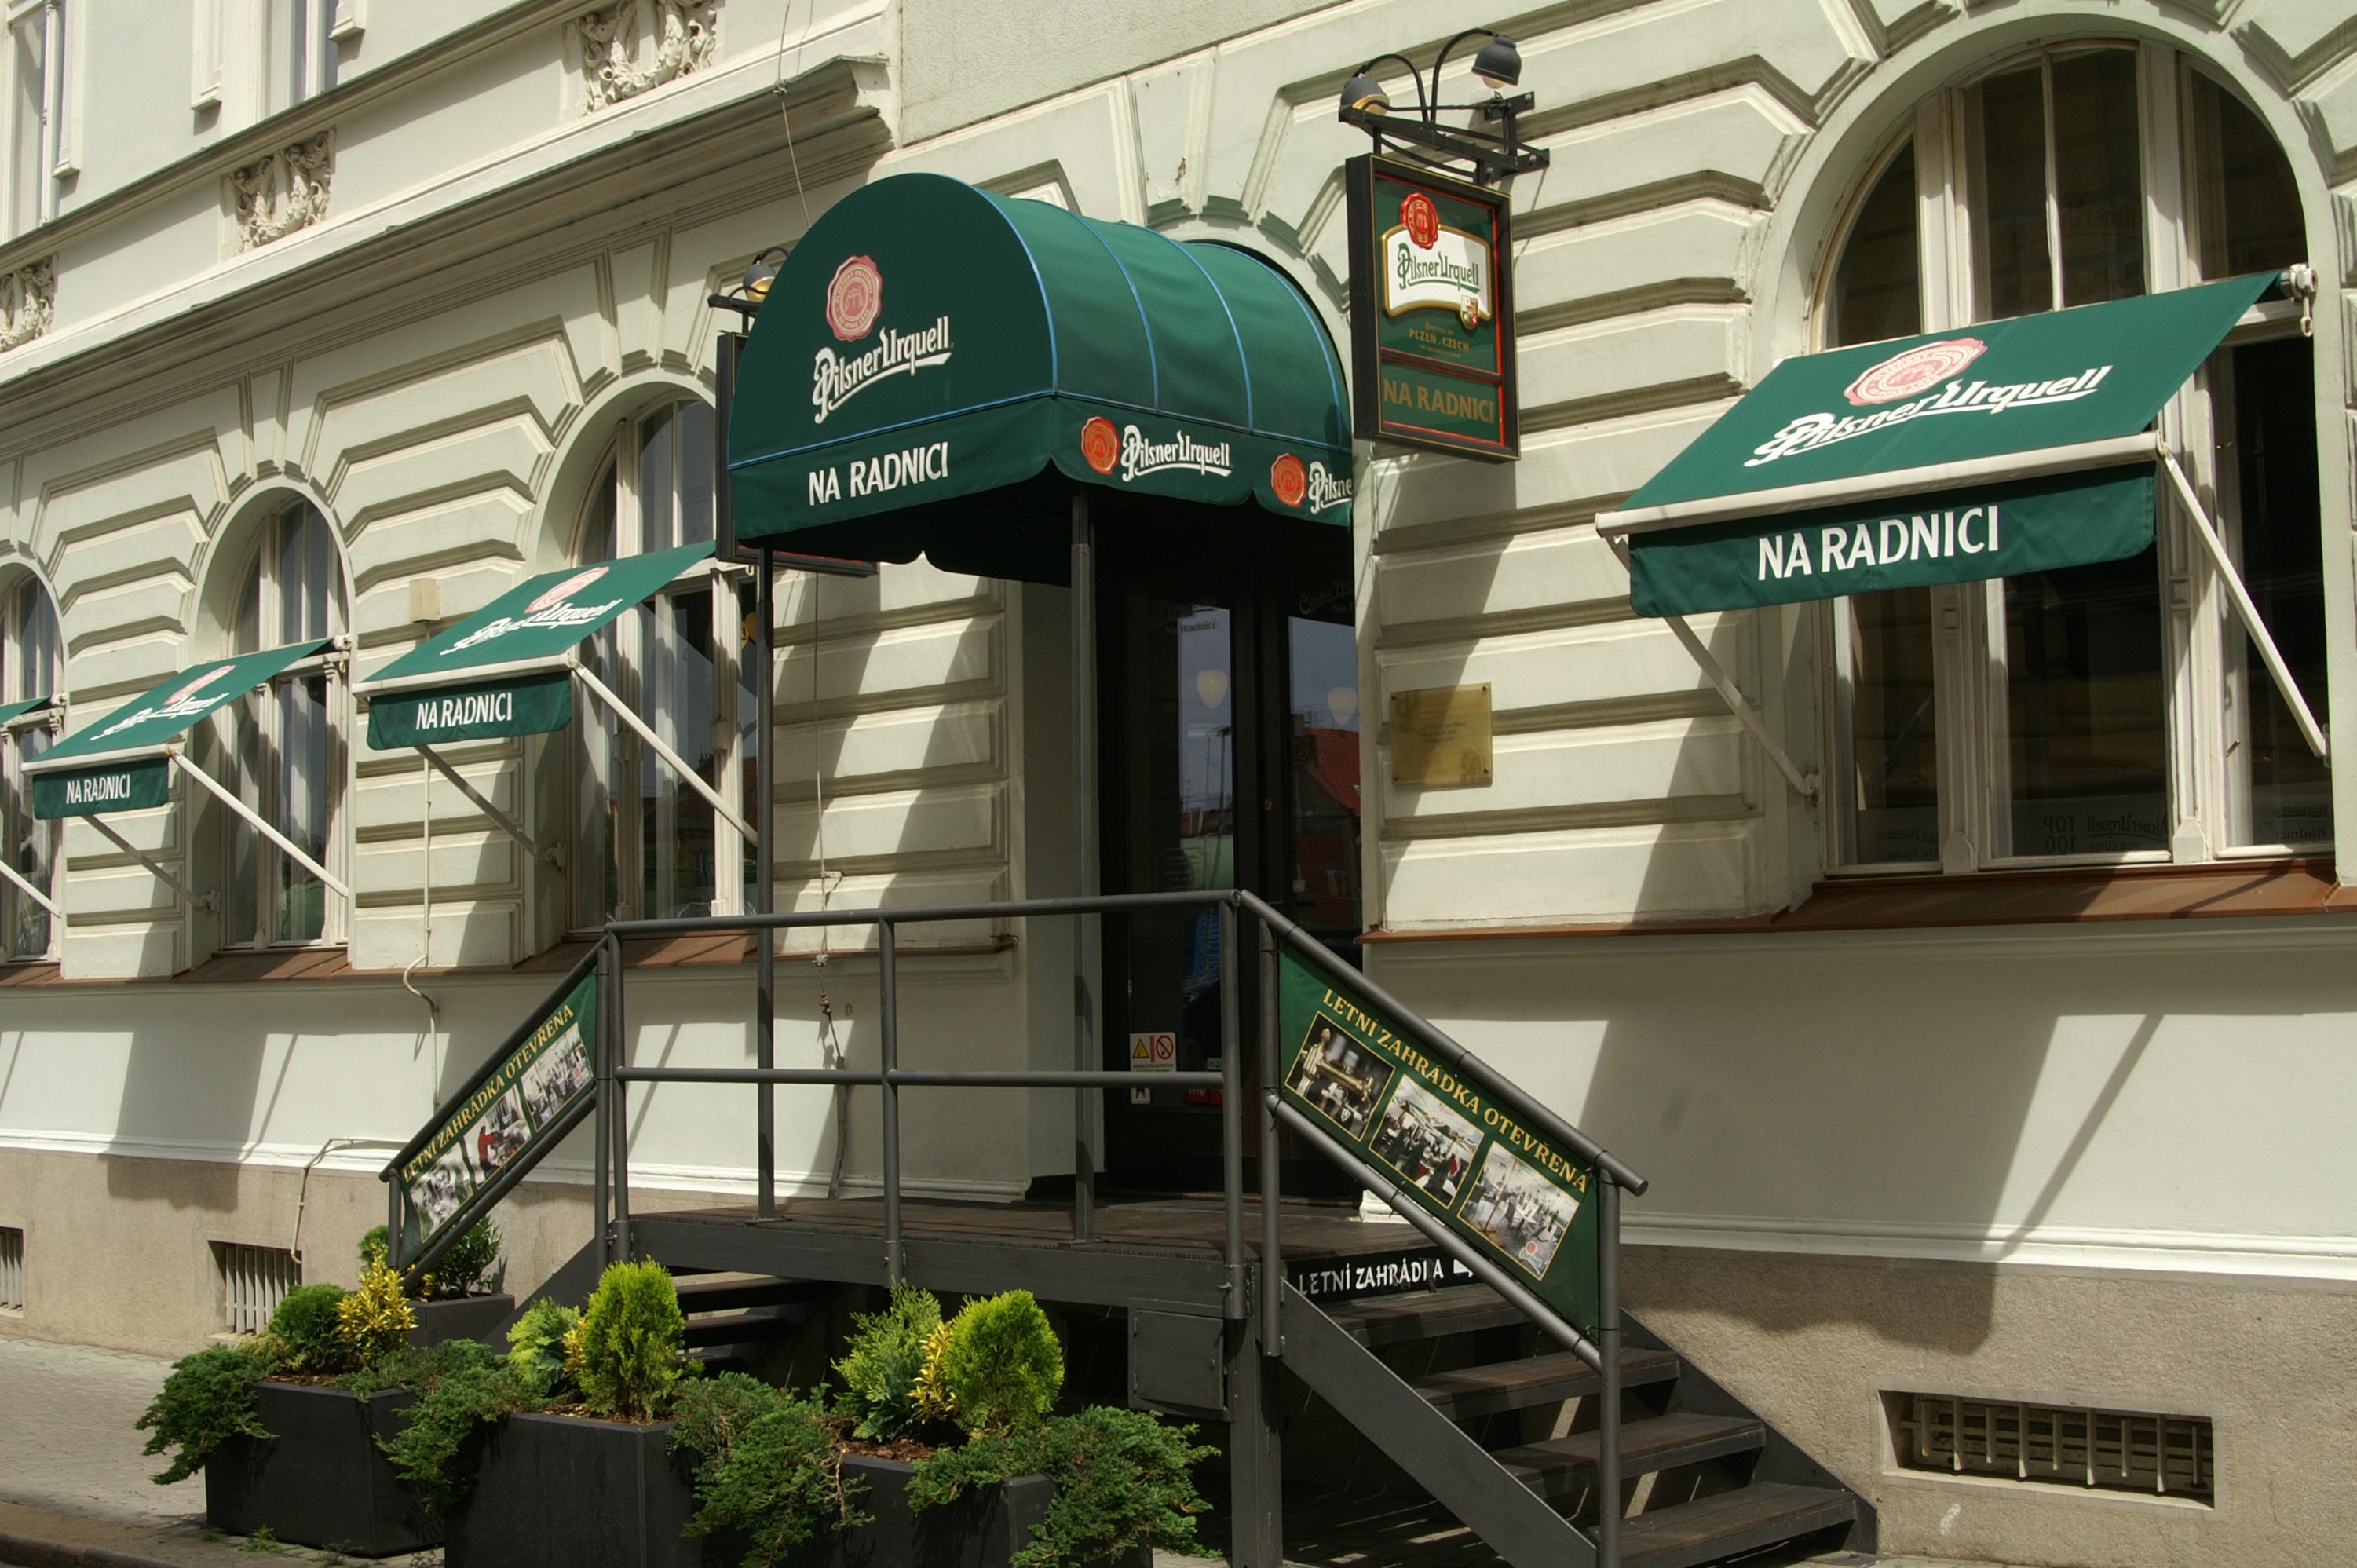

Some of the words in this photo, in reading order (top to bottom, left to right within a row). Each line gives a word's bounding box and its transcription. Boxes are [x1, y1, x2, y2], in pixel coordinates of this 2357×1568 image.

[1398, 242, 1439, 291] Pilsner
[1438, 251, 1479, 291] Urquell
[812, 346, 883, 424] Pilsner
[879, 316, 949, 377] Urquell
[1442, 337, 1470, 352] CZECH
[1383, 377, 1412, 408] NA
[1416, 385, 1496, 424] RADNICI
[1743, 393, 1941, 466] Pilsner
[1928, 364, 2114, 414] Urquell
[809, 467, 841, 506] NA
[850, 442, 948, 498] RADNICI
[1120, 424, 1178, 482] Pilsner
[1176, 430, 1230, 476] Urquell
[1307, 461, 1353, 514] Pilsne
[1759, 532, 1812, 581] NA
[1821, 505, 1999, 573] RADNICI
[415, 701, 437, 730] NA
[440, 692, 513, 727] RADNICI
[66, 780, 82, 805] NA
[83, 773, 131, 803] RADNICI
[437, 1074, 505, 1148] ZAHRÁDKA
[505, 1004, 575, 1080] OTEVŘENA
[1321, 988, 1380, 1037] LETNÍ
[1377, 1029, 1481, 1114] ZAHRÁDKA
[1483, 1107, 1590, 1194] OTEVŘENA
[1299, 1263, 1350, 1296] LETNÍ
